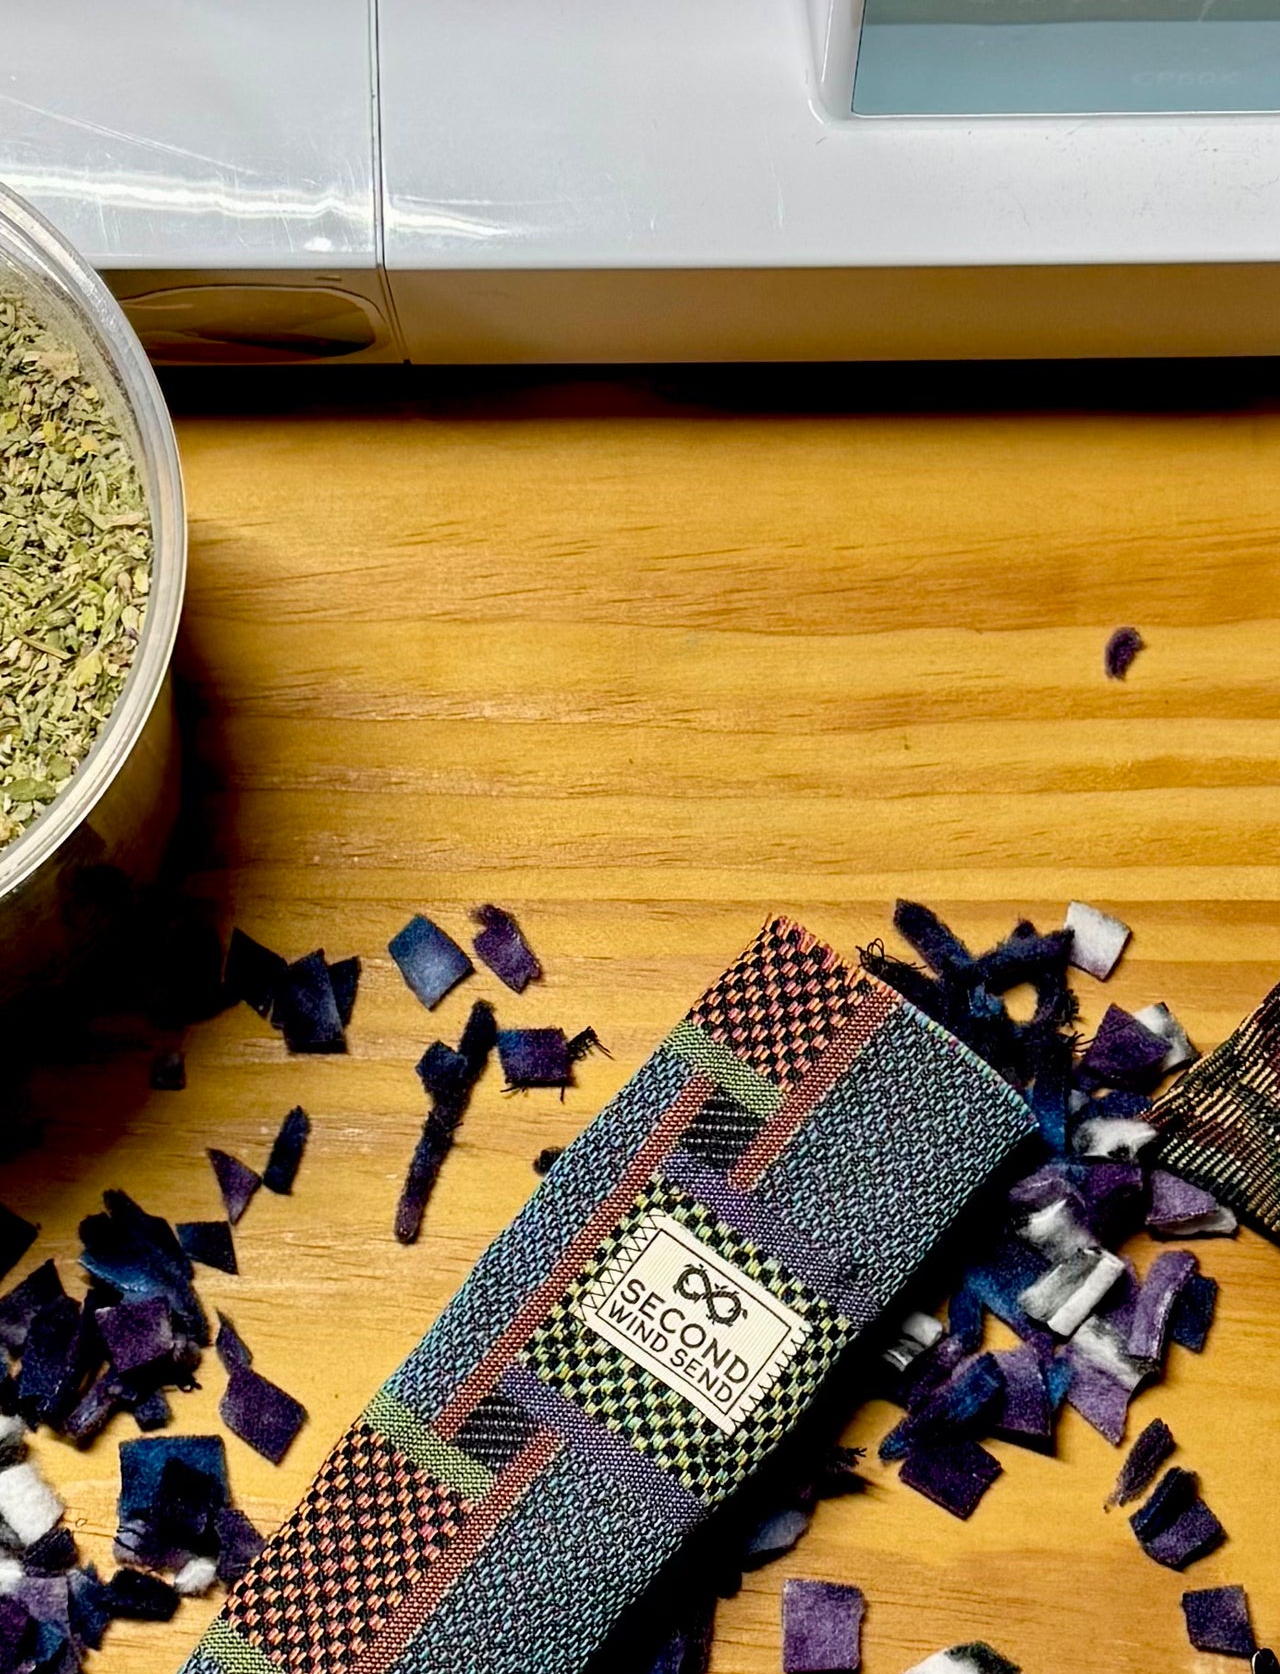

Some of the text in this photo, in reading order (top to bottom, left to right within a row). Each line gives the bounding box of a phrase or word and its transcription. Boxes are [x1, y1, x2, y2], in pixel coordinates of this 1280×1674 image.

[608, 1300, 733, 1403] WIND SEND
[620, 1278, 749, 1384] SECOND
